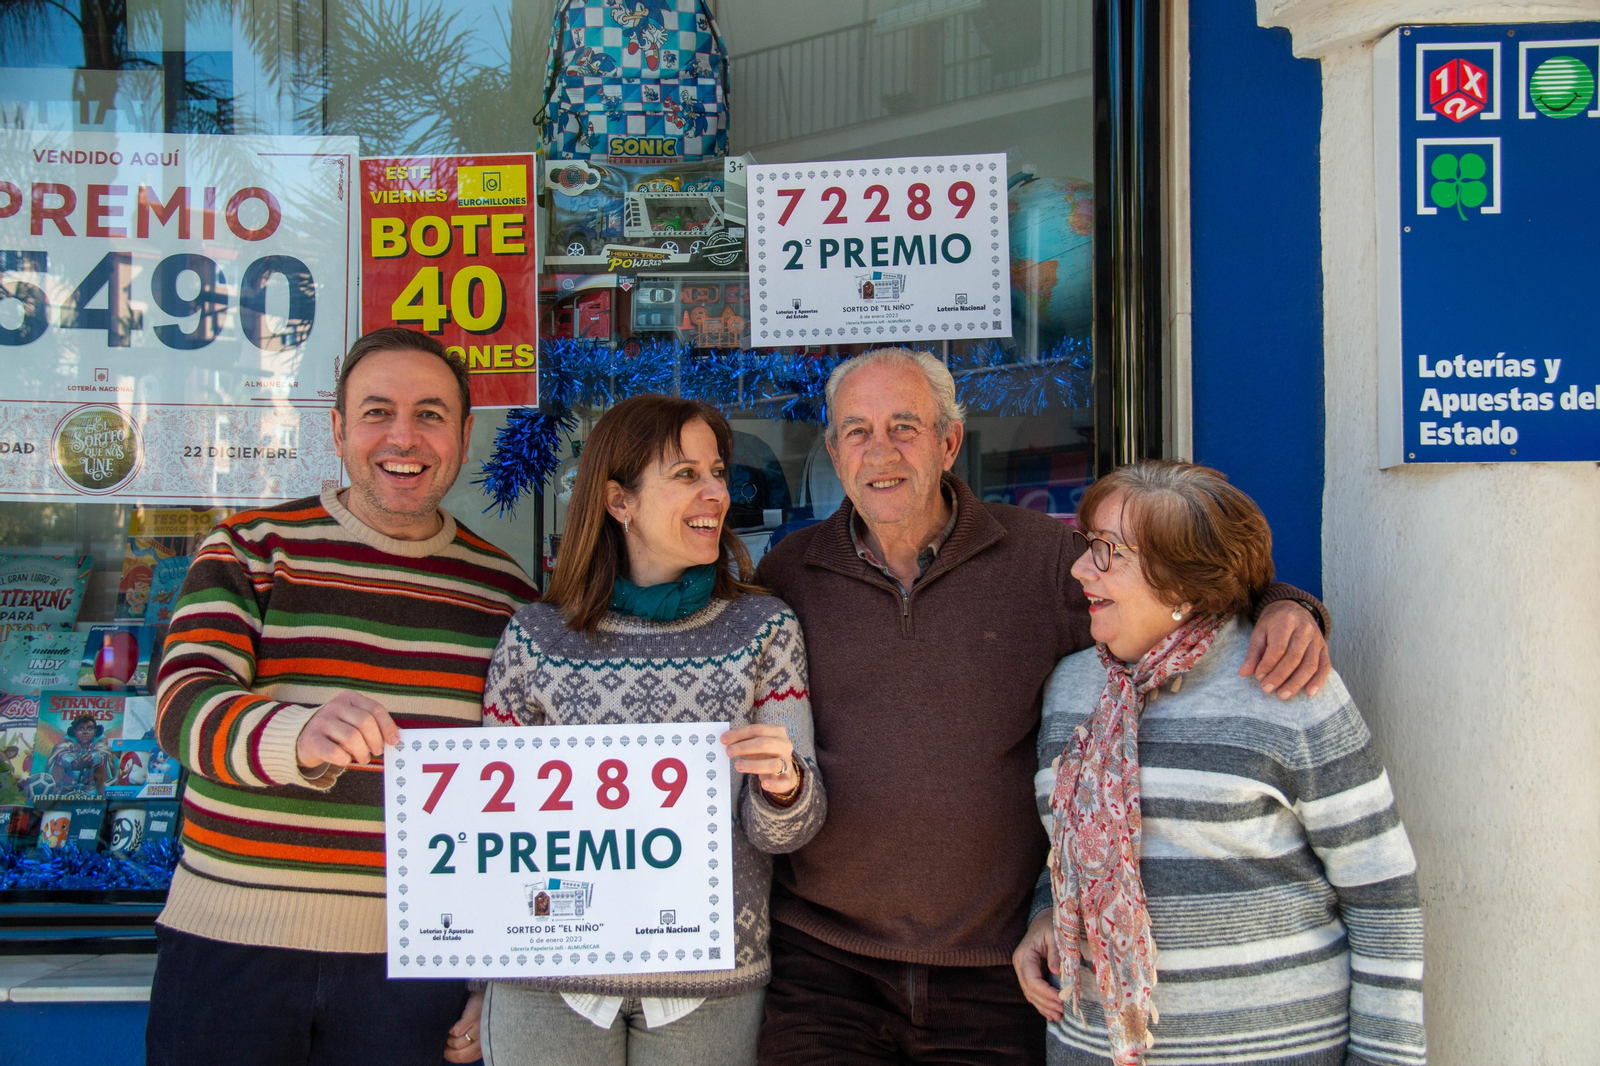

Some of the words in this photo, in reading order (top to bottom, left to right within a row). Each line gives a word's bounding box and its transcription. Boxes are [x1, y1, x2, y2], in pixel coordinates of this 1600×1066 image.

[610, 138, 677, 156] SONIC
[32, 149, 124, 166] VENDIDO
[130, 149, 180, 167] AQUÍ
[386, 166, 432, 181] ESTE
[728, 161, 744, 173] 3+
[370, 188, 448, 205] VIERNES
[458, 197, 527, 207] EUROMILLONES
[776, 180, 976, 227] 72289
[371, 213, 527, 259] BOTE
[819, 232, 972, 269] PREMIO
[607, 257, 663, 272] POWERED
[0, 250, 317, 351] 5490
[391, 265, 507, 335] 40
[842, 305, 869, 313] SORTEO
[1418, 352, 1536, 378] Loterías
[1544, 358, 1562, 384] y
[1419, 387, 1554, 418] Apuestas
[1560, 385, 1600, 411] del
[71, 429, 125, 453] SORTEO
[1419, 420, 1518, 446] Estado
[85, 447, 103, 458] QUE
[105, 443, 124, 459] NOS
[183, 446, 203, 458] 22
[208, 447, 297, 460] DICIEMBRE
[153, 513, 212, 525] TESORO
[8, 573, 28, 584] GRAN
[31, 573, 50, 584] LIBRO
[0, 611, 34, 621] PARA
[32, 647, 71, 655] mundo
[28, 658, 66, 670] INDY
[49, 695, 125, 712] STRANGER
[422, 757, 688, 815] 72289
[477, 828, 682, 874] PREMIO
[507, 925, 542, 934] SORTEO
[545, 925, 555, 933] DE
[635, 926, 665, 935] Lotería
[666, 925, 700, 933] Nacional
